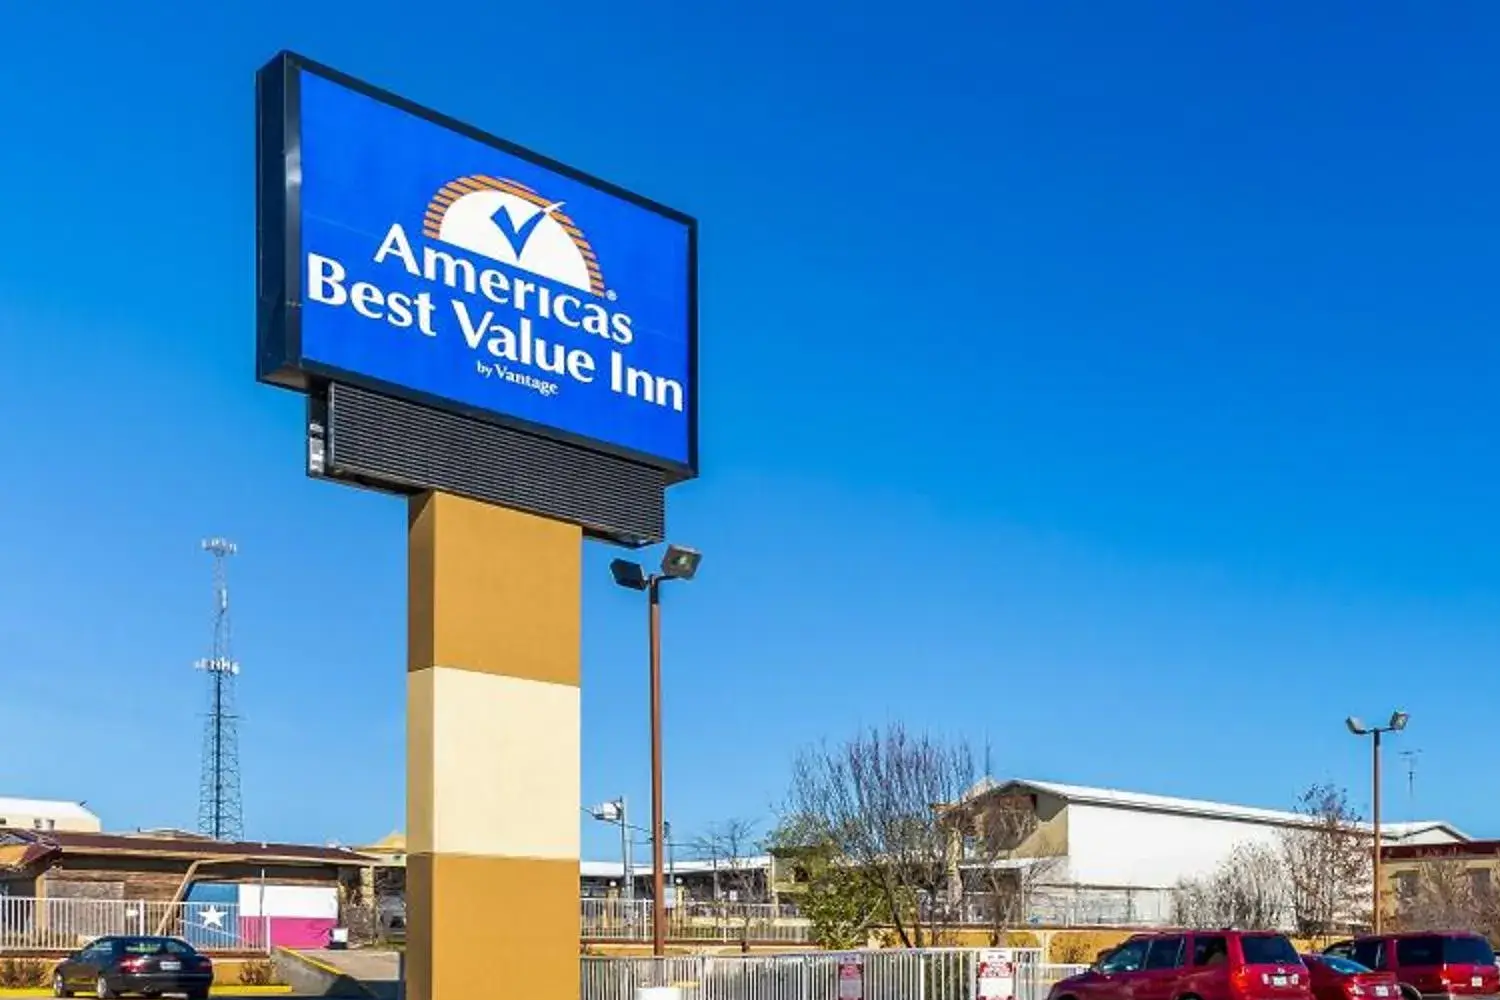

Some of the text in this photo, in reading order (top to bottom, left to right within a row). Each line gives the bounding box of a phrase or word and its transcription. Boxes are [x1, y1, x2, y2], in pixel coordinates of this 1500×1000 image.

[308, 253, 683, 411] Best Value Inn
[374, 223, 633, 344] Americas
[476, 360, 559, 397] by Vantage
